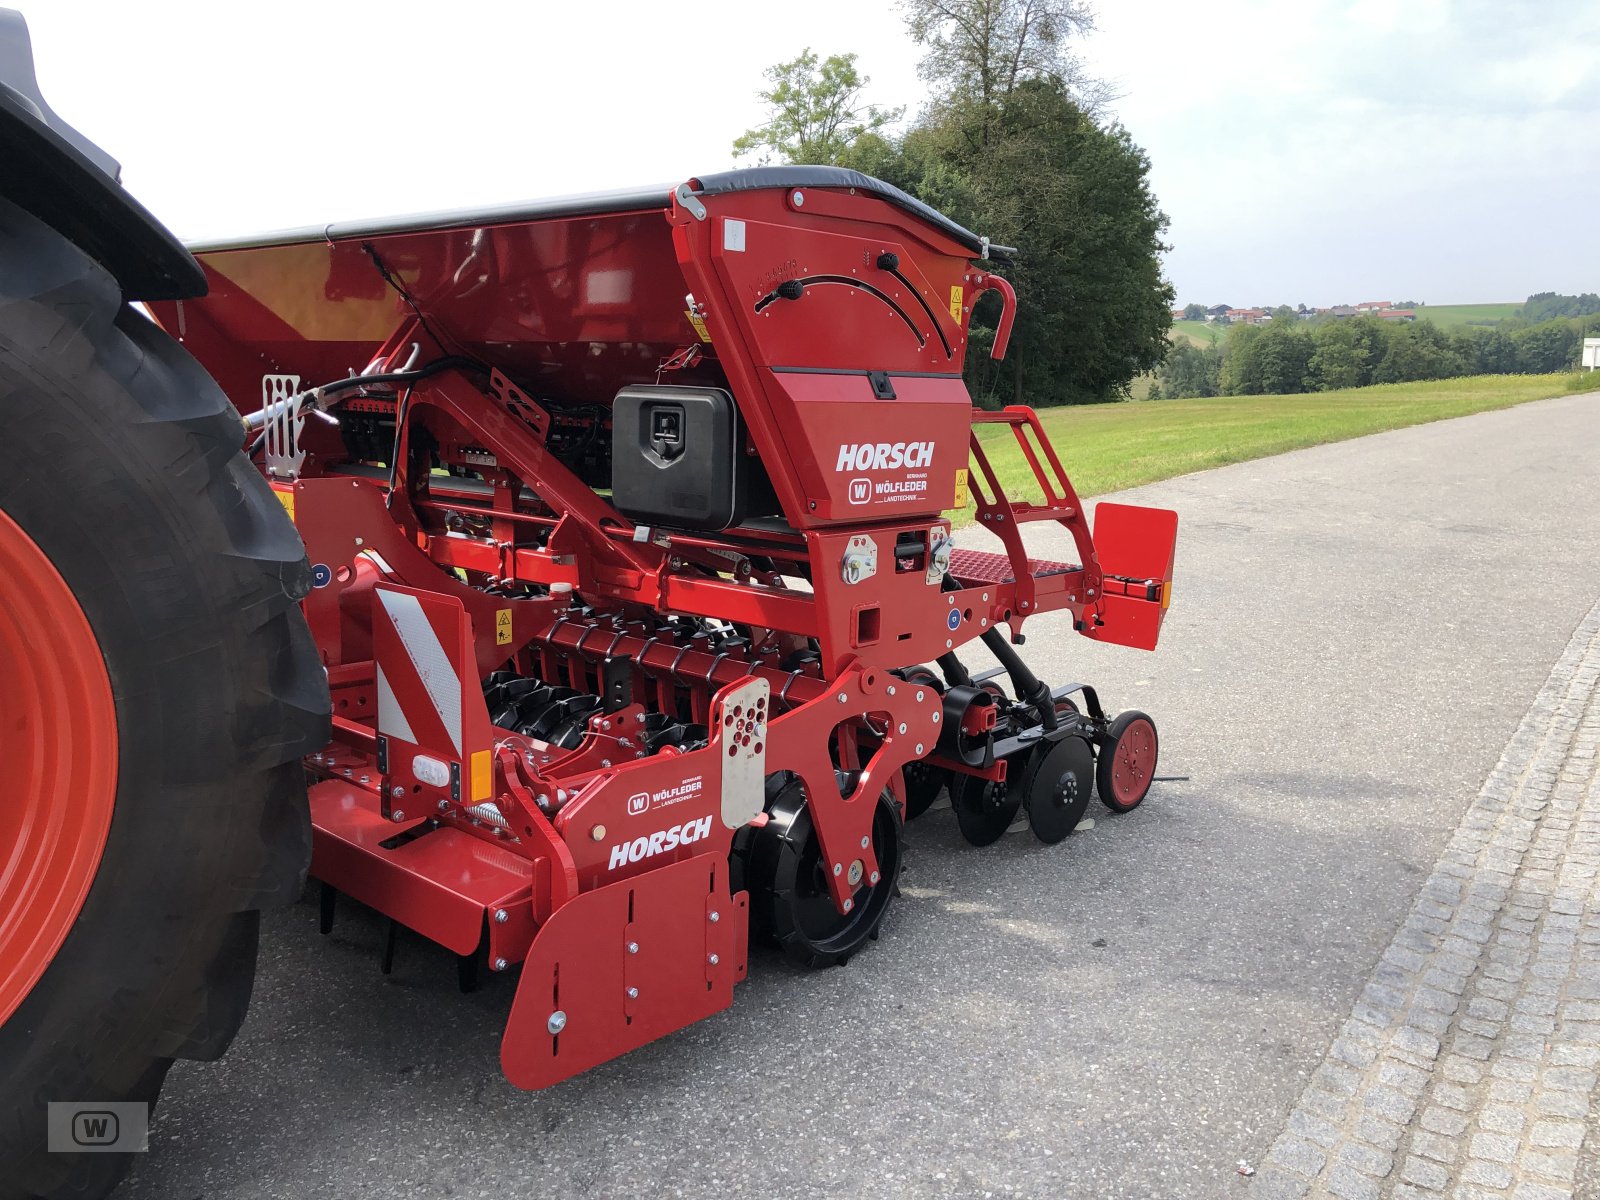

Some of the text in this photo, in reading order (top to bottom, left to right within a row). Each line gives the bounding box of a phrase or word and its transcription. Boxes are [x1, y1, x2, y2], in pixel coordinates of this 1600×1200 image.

[836, 441, 935, 471] HORSCH
[854, 484, 867, 498] W
[875, 480, 927, 494] WÖLFLEDER
[883, 494, 917, 503] LANDTECHNIK
[652, 781, 702, 802] WÖLFLEDER
[633, 797, 645, 811] W
[661, 794, 693, 807] LANDTECHNIK
[608, 815, 713, 871] HORSCH
